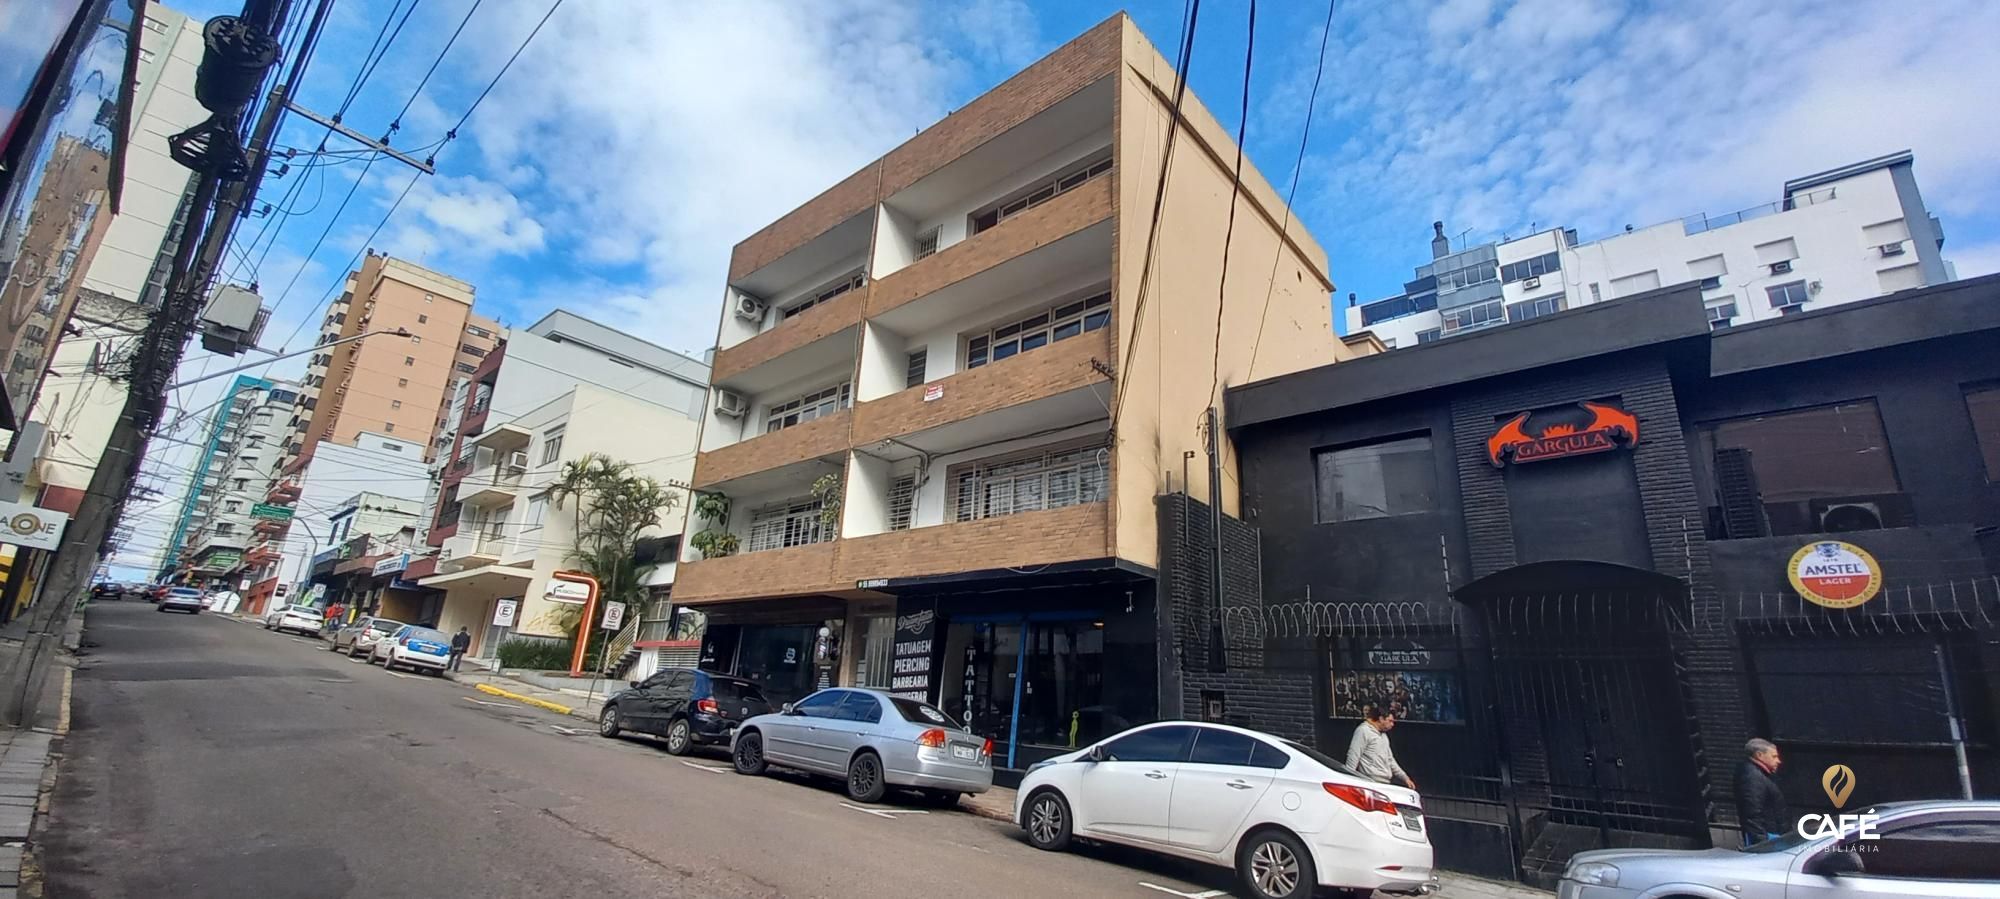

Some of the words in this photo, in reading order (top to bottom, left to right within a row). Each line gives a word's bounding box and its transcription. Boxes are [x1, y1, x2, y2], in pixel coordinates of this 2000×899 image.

[1805, 563, 1862, 575] AMSTEL
[1819, 577, 1852, 585] LAGER
[896, 640, 932, 655] TATUAGEM
[894, 657, 930, 673] PIERCING
[892, 675, 928, 689] BARBEARIA
[963, 649, 976, 735] TATTOO
